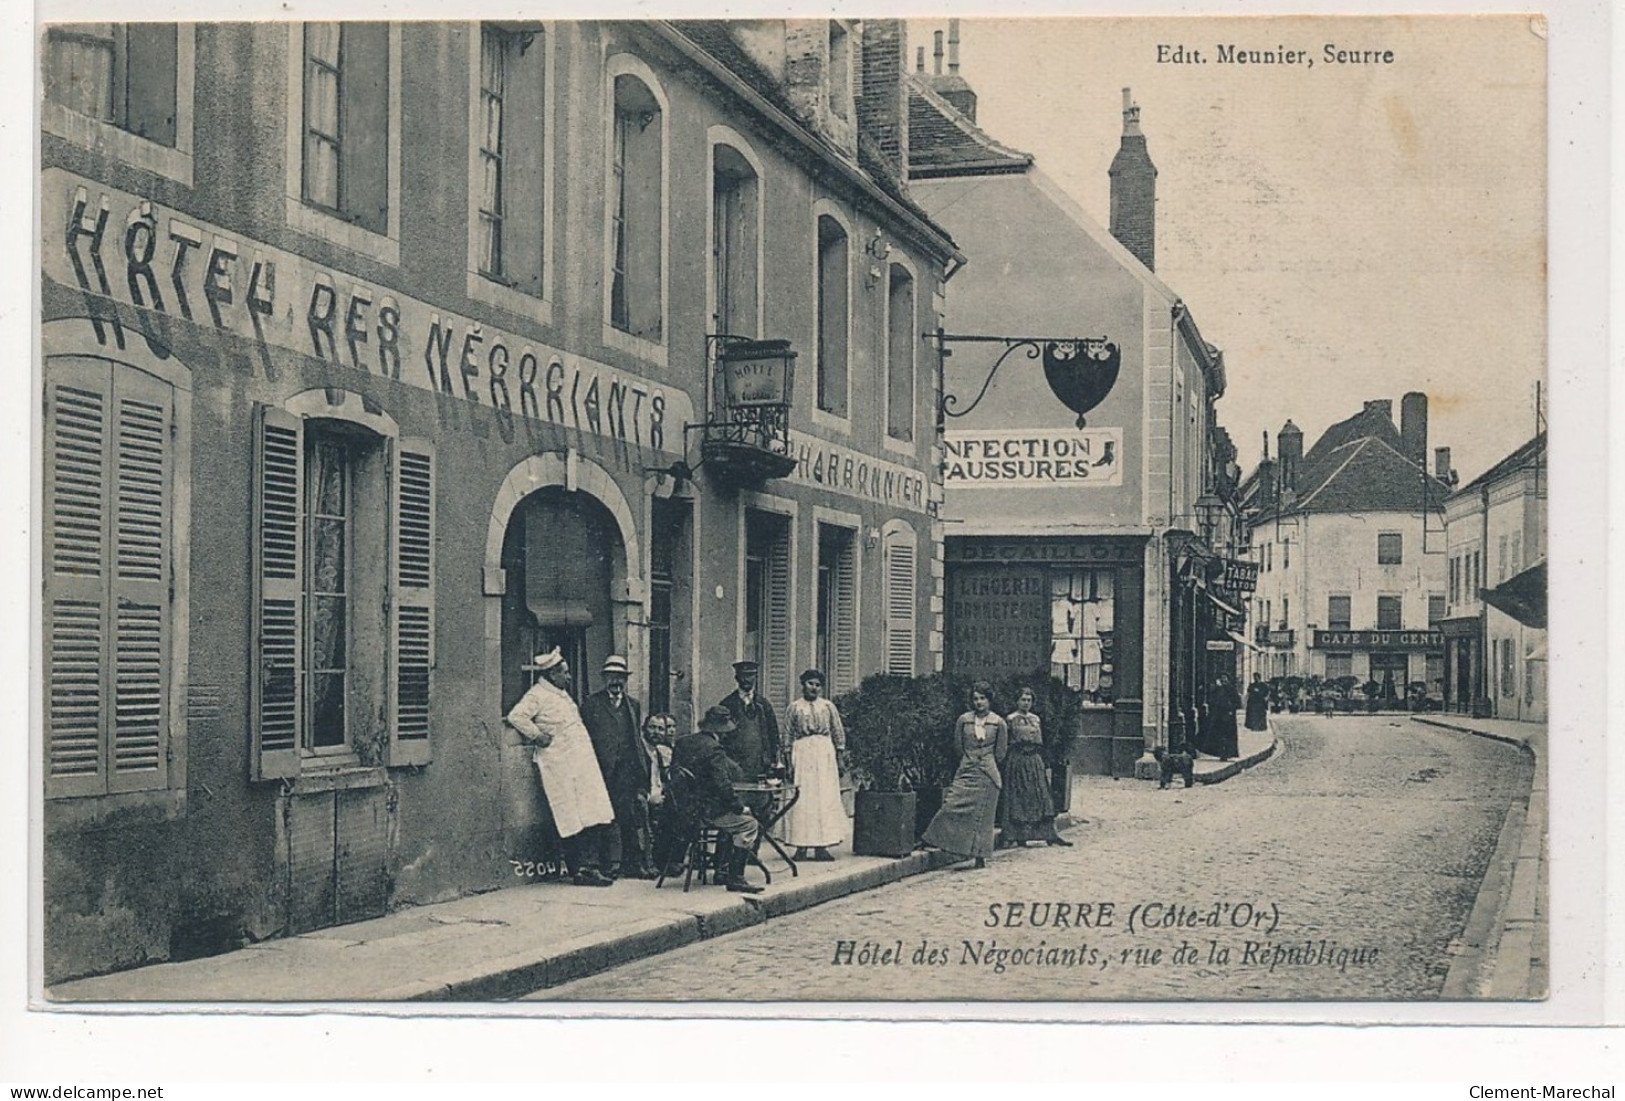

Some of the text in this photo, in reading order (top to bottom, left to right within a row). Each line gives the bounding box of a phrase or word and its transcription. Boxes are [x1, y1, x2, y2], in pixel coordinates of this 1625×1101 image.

[425, 311, 665, 424] NÉGOCIANTS
[779, 440, 923, 508] HARBONNIER
[1371, 633, 1391, 645] DU
